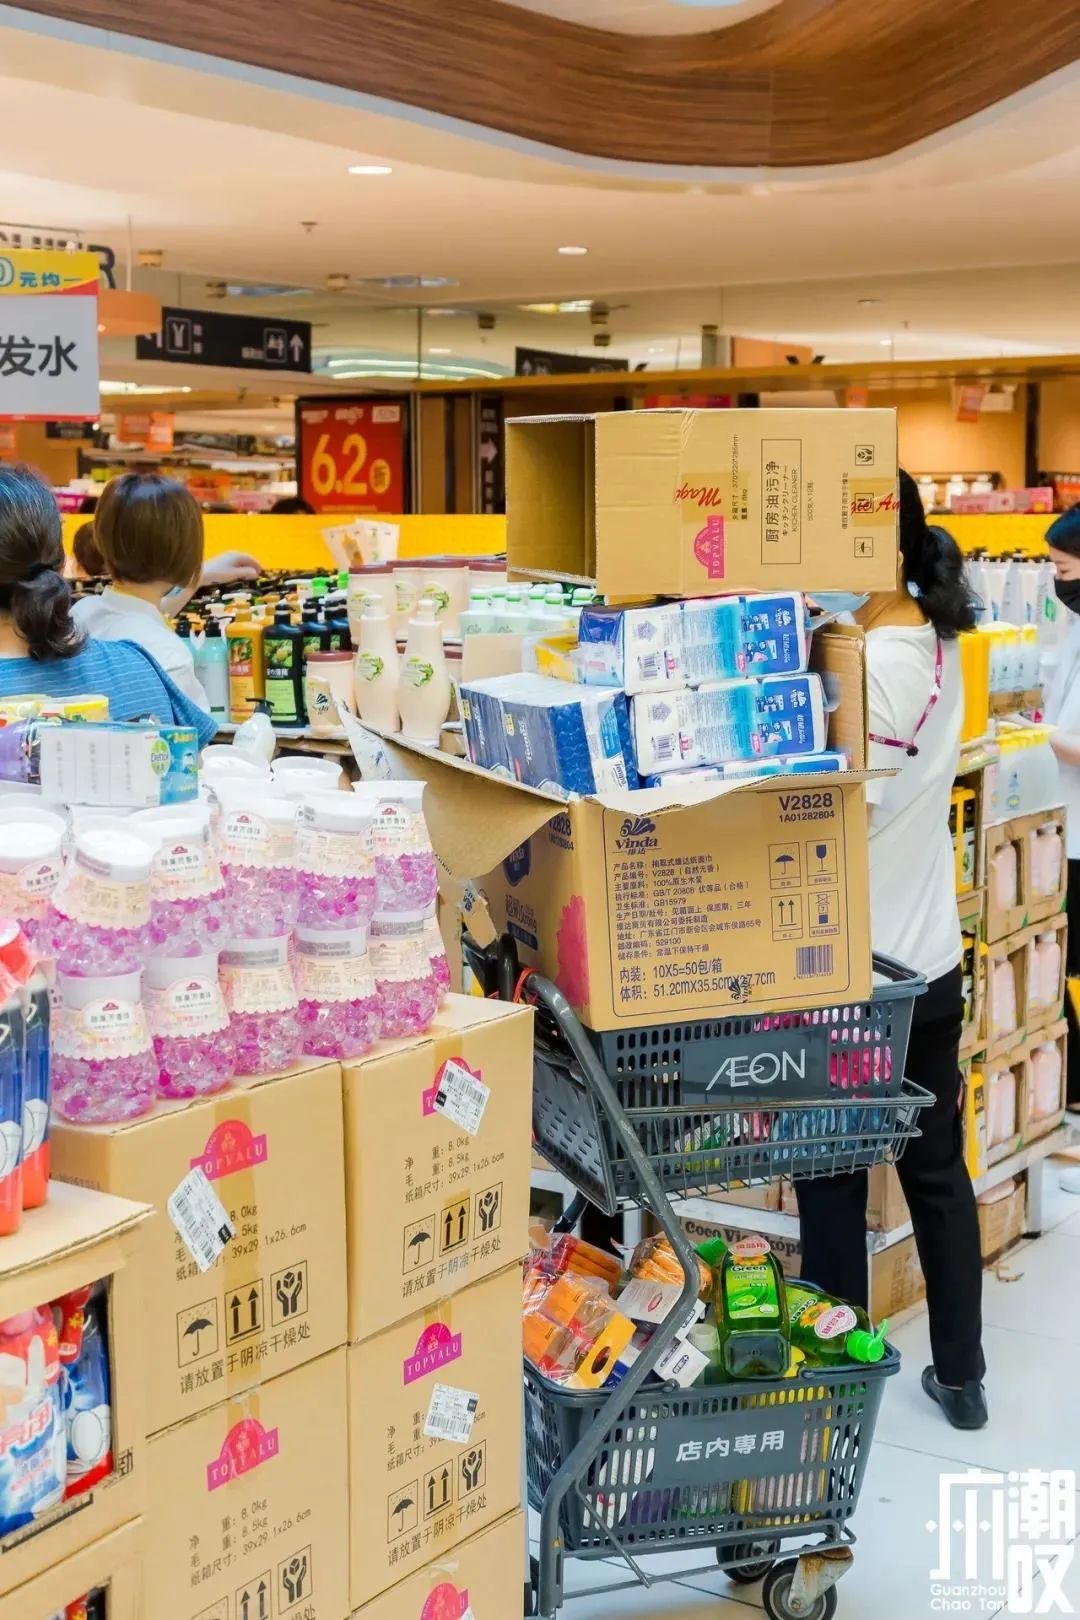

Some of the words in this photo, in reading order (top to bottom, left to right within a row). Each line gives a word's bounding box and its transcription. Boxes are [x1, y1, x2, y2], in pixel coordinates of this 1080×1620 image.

[311, 433, 367, 496] 6.2
[765, 460, 780, 543] 厨房油污净
[712, 519, 720, 575] TOPVALU
[778, 793, 833, 812] V2828
[615, 837, 658, 850] Vinda
[204, 1143, 263, 1174] OPVALU
[402, 1237, 502, 1298] 请放置于阴凉干燥处
[179, 1320, 311, 1395] 请放置于阴凉干燥处
[407, 1339, 460, 1377] TOPVALU
[387, 1494, 487, 1566] 请放置于阴凉干燥处
